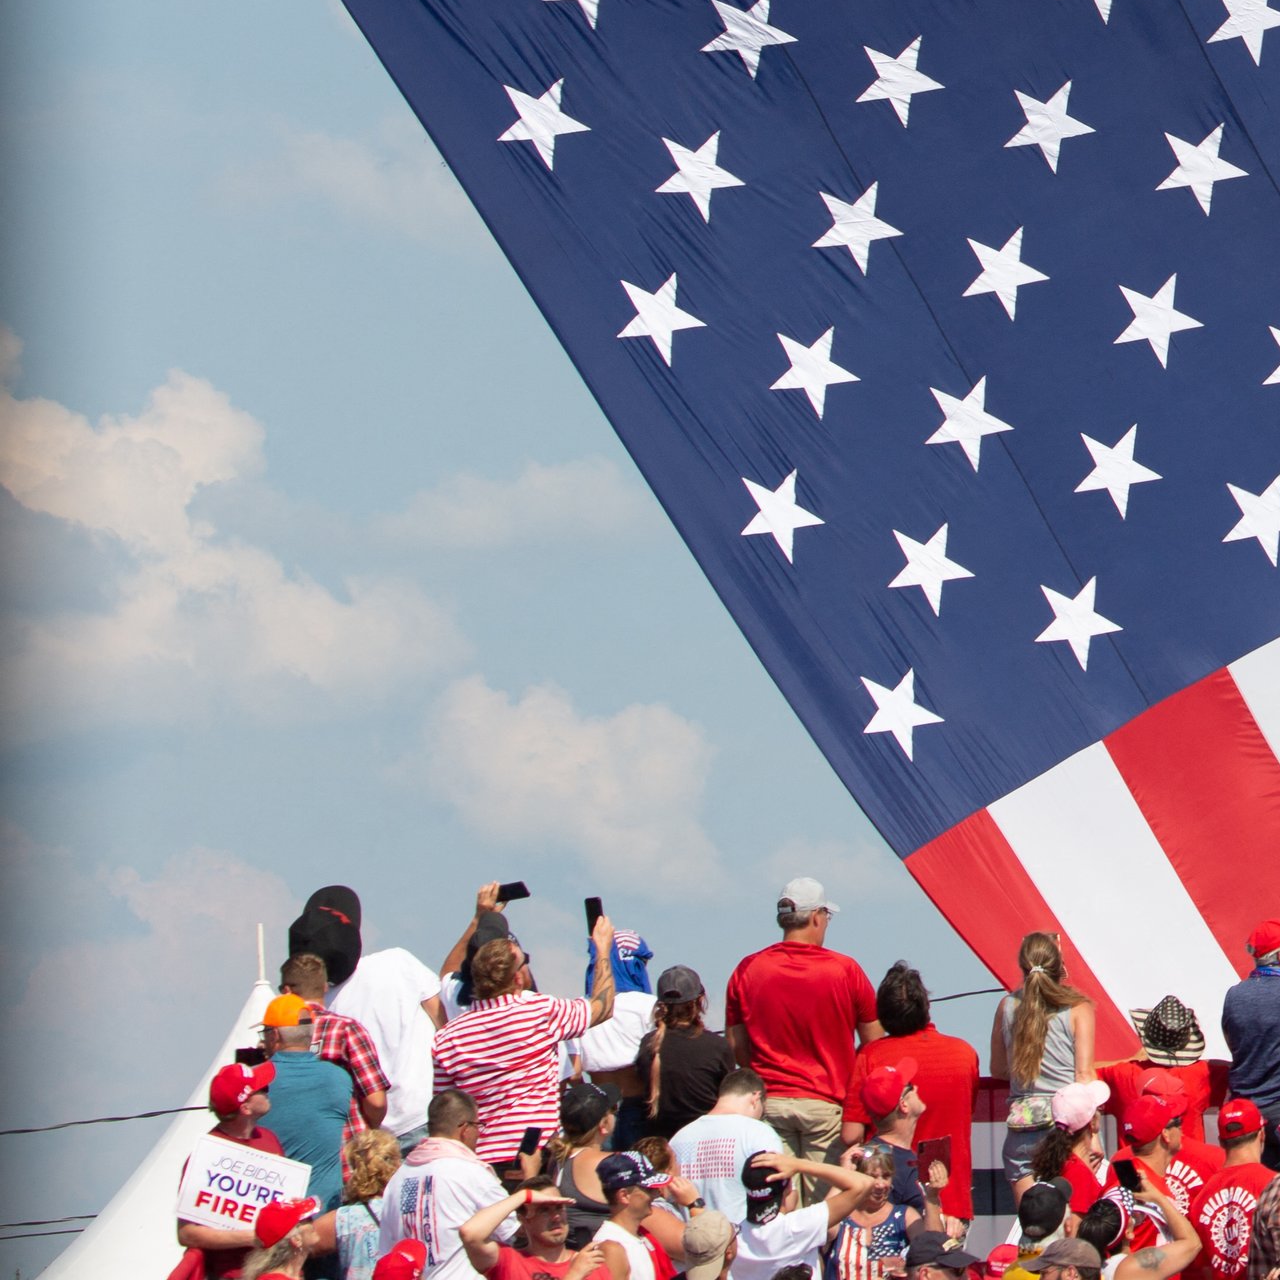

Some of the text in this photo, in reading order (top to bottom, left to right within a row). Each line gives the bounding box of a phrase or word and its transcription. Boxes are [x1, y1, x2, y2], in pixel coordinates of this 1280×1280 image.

[212, 1156, 245, 1175] JOE
[206, 1169, 285, 1205] YOU'RE
[194, 1190, 257, 1223] FIRE
